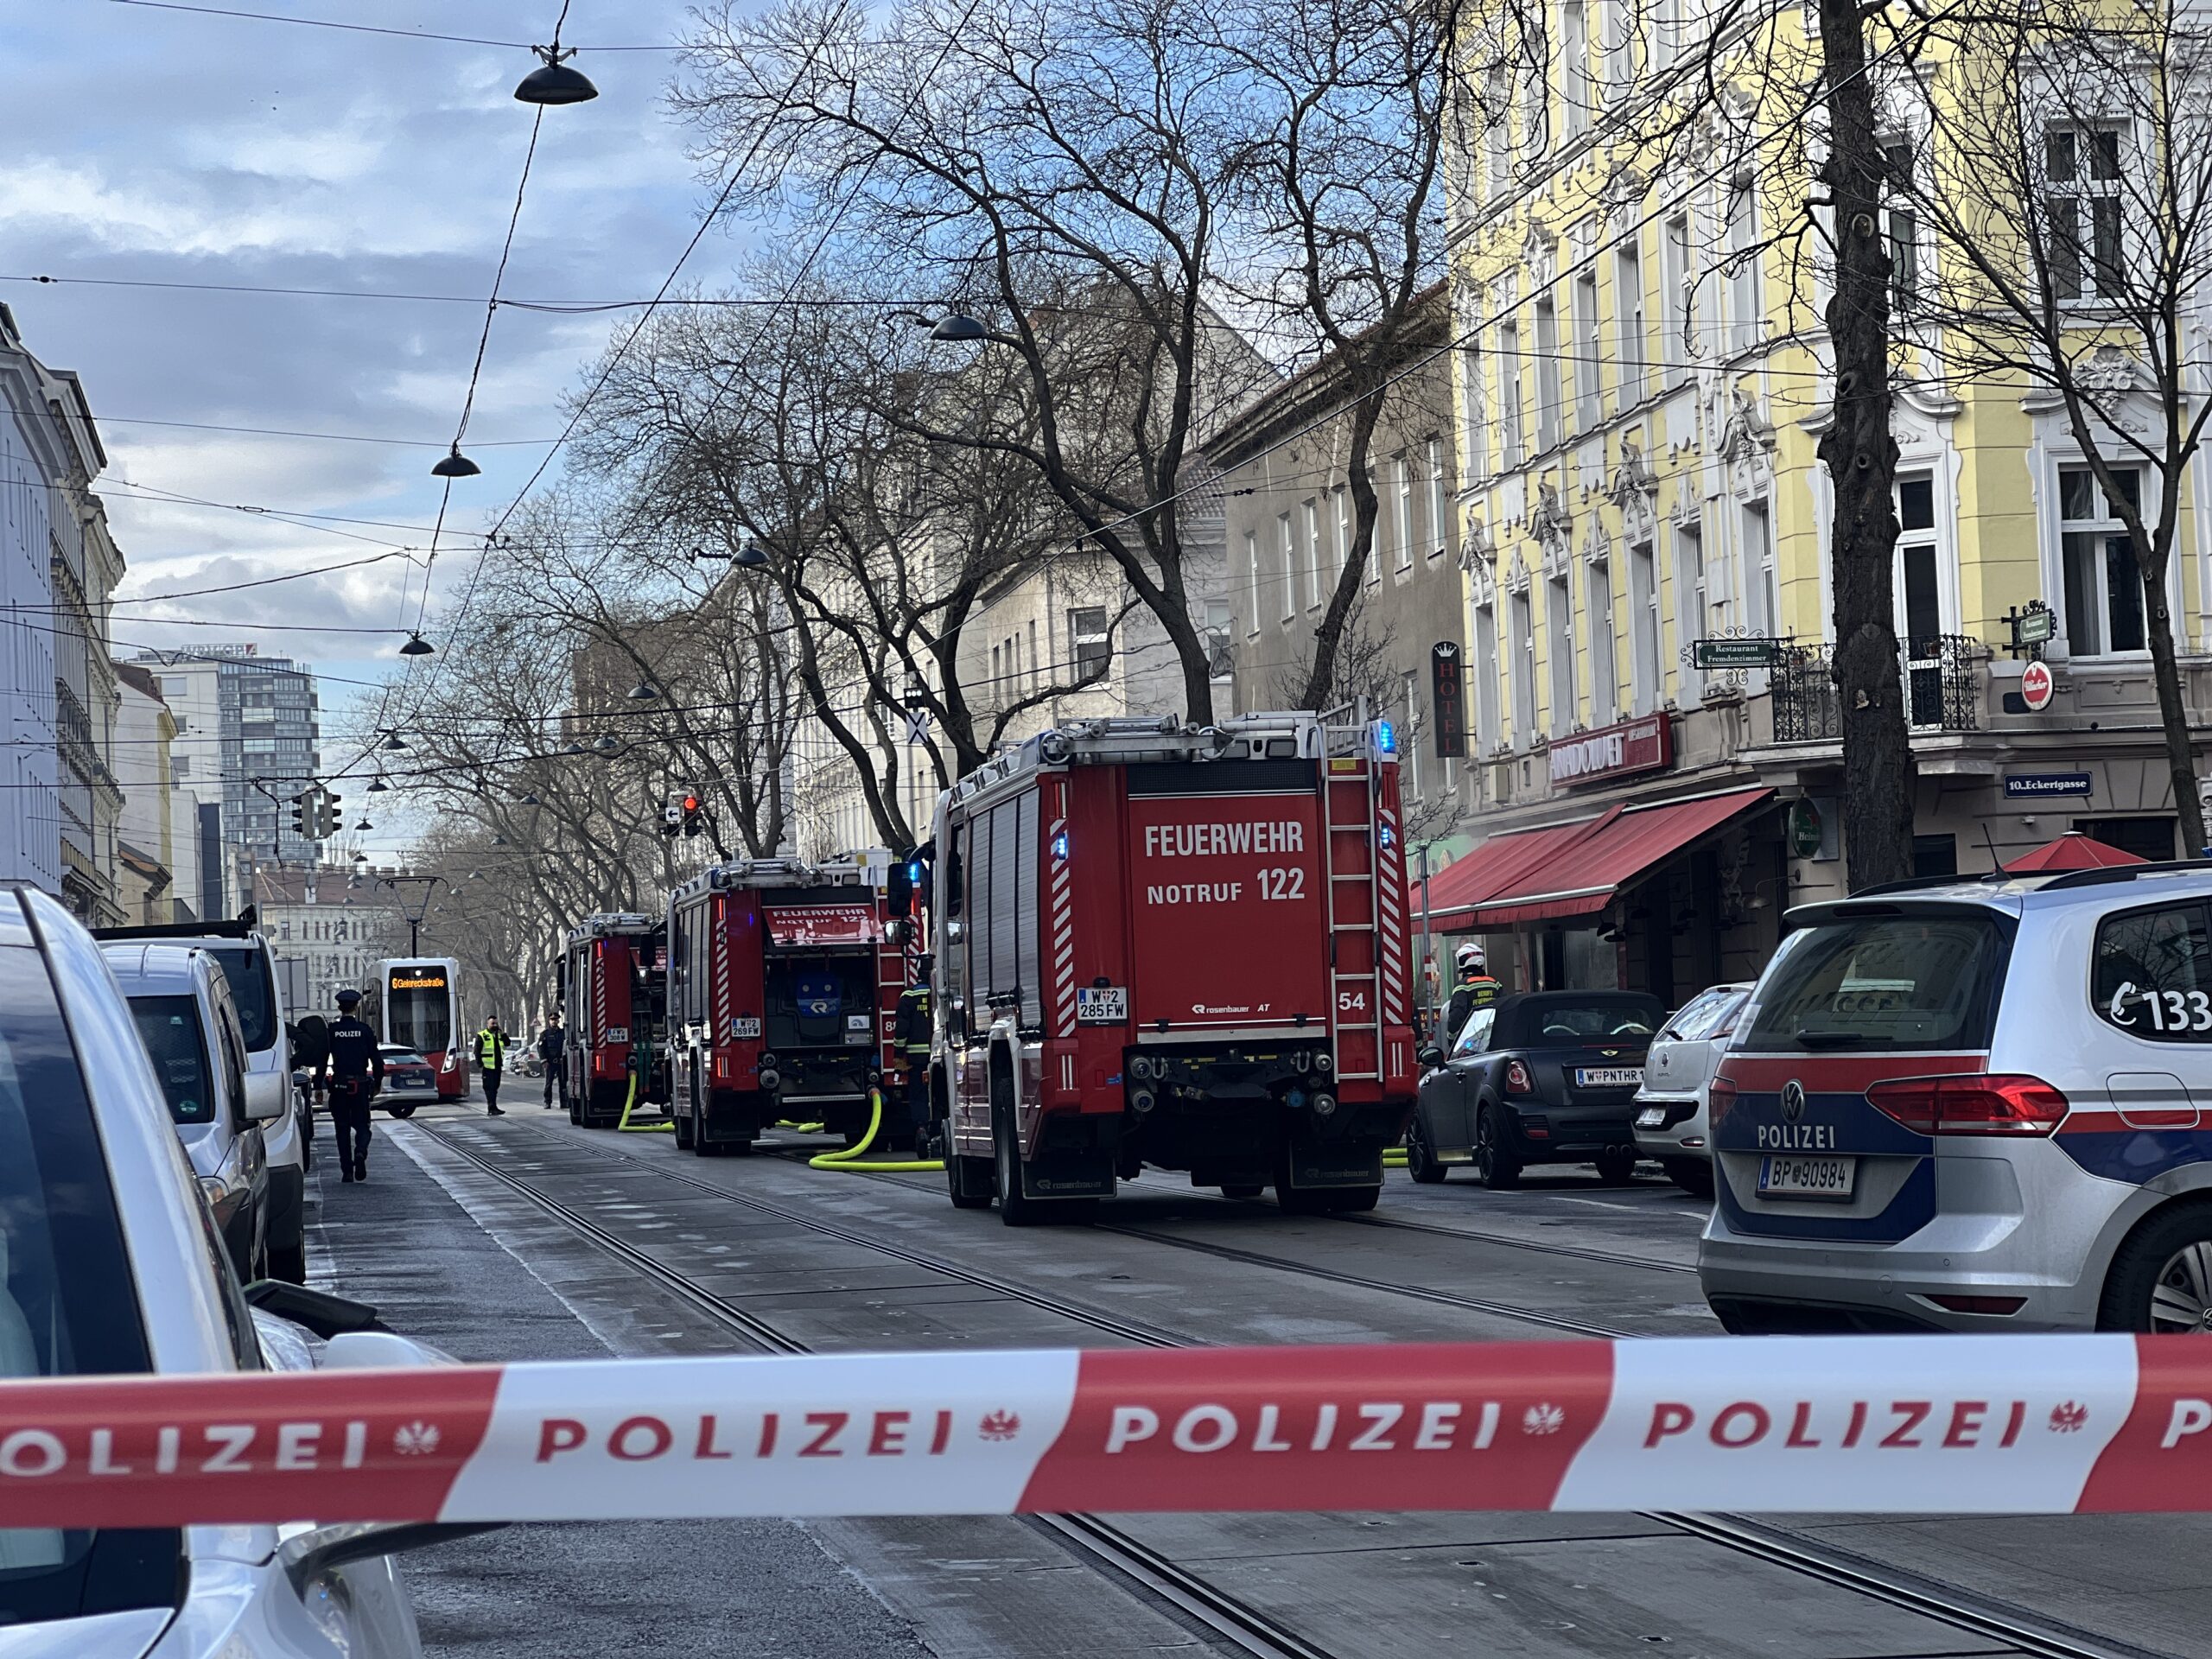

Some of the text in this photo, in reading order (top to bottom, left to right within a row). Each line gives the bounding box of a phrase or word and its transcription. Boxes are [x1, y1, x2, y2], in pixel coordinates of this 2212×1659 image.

[1707, 654, 1767, 663] Fremdenzimmer
[1439, 663, 1457, 753] HOTEL
[1145, 821, 1304, 857] FEUERWEHR
[1147, 868, 1305, 905] NOTRUF 122
[772, 908, 867, 918] FEUERWEHR
[391, 977, 397, 989] 6
[1206, 1005, 1249, 1014] rosenbauer
[1257, 1003, 1270, 1012] AT
[1338, 992, 1366, 1010] 54
[2142, 990, 2212, 1031] 133
[1586, 1071, 1595, 1083] W
[1603, 1070, 1637, 1082] PNTHR
[1758, 1125, 1834, 1148] POLIZEI
[1772, 1160, 1791, 1186] BP
[1801, 1161, 1846, 1189] 90984
[535, 1410, 952, 1463] POLIZEI
[1105, 1402, 1501, 1454] POLIZEI
[1642, 1401, 2026, 1449] POLIZEI
